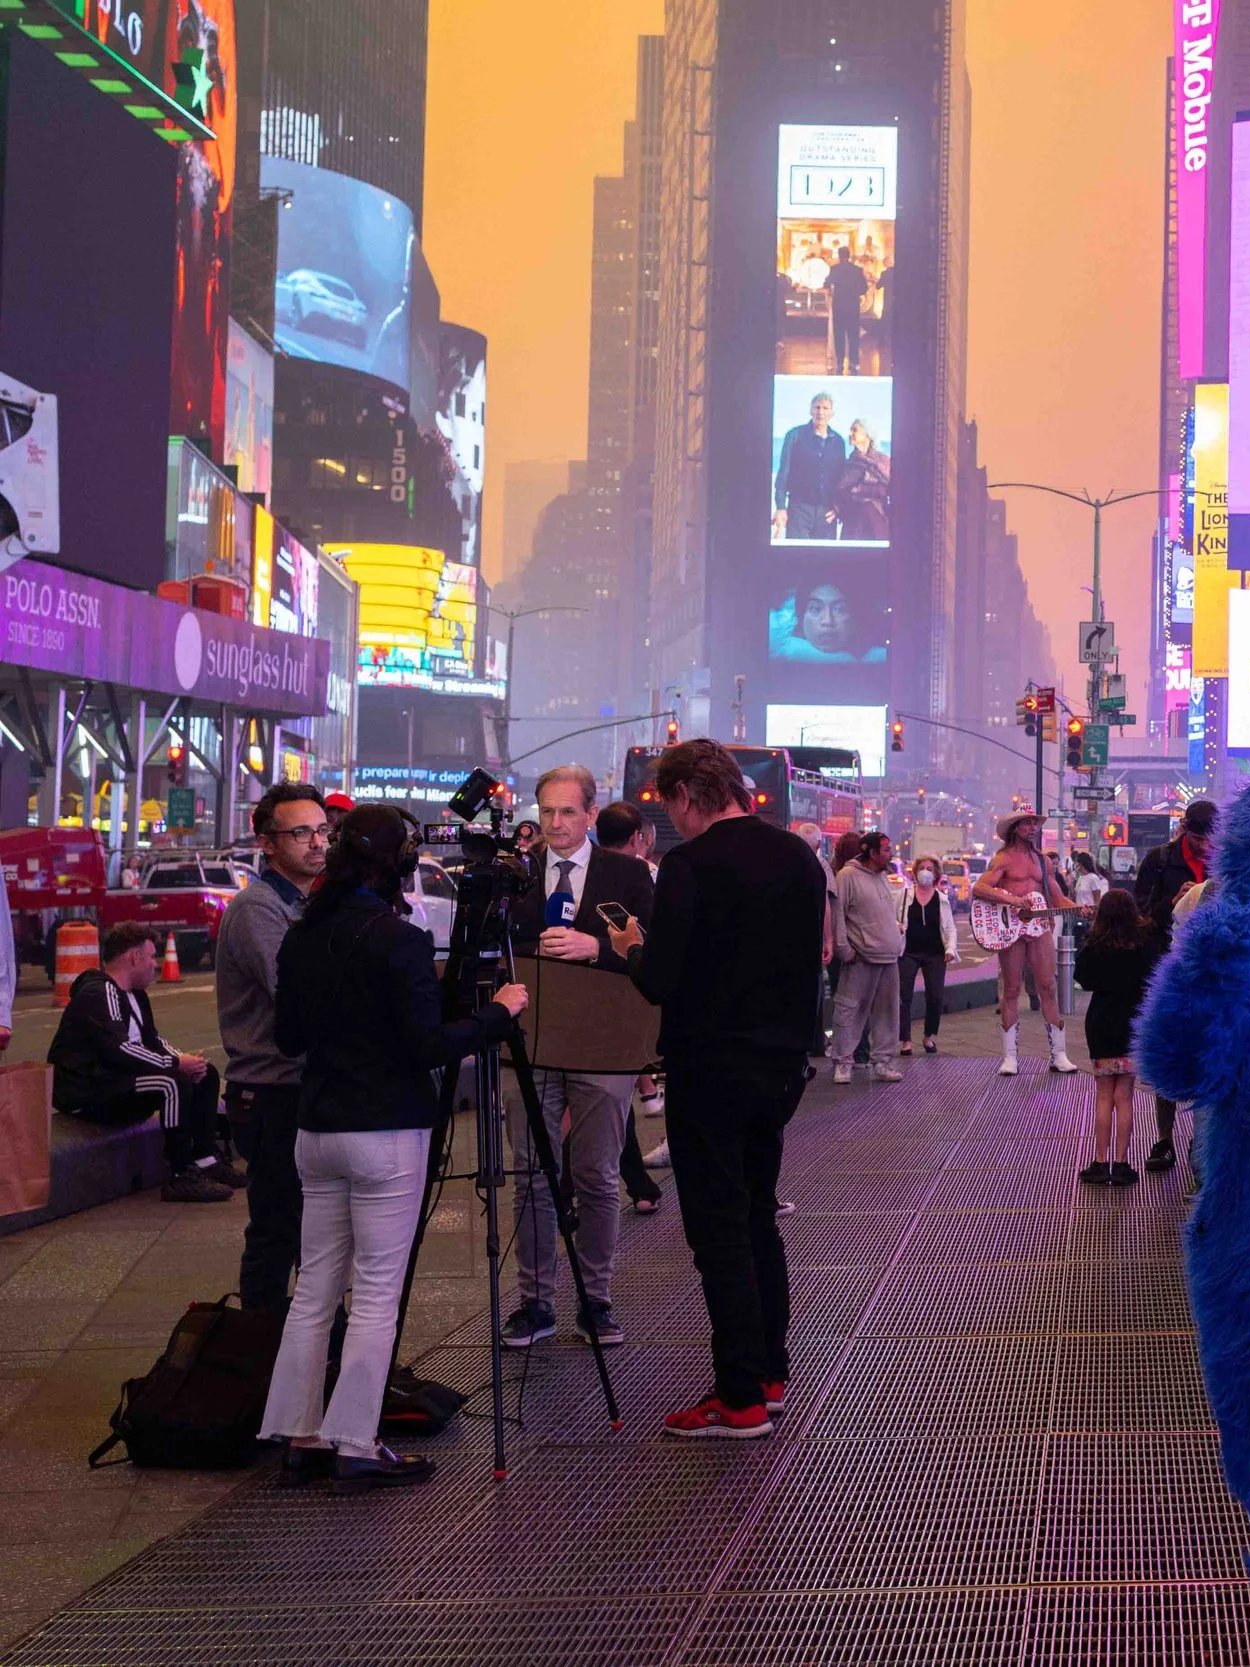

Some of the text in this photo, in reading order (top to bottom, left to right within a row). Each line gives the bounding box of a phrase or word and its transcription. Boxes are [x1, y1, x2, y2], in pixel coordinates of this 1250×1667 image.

[390, 429, 406, 502] 1500
[5, 575, 101, 629] POLO ASSN.
[8, 621, 40, 647] SINCE
[206, 633, 281, 697] sunglass
[282, 644, 309, 696] hut
[1084, 651, 1109, 660] ONLY
[646, 747, 663, 757] 347
[362, 769, 409, 781] prepare
